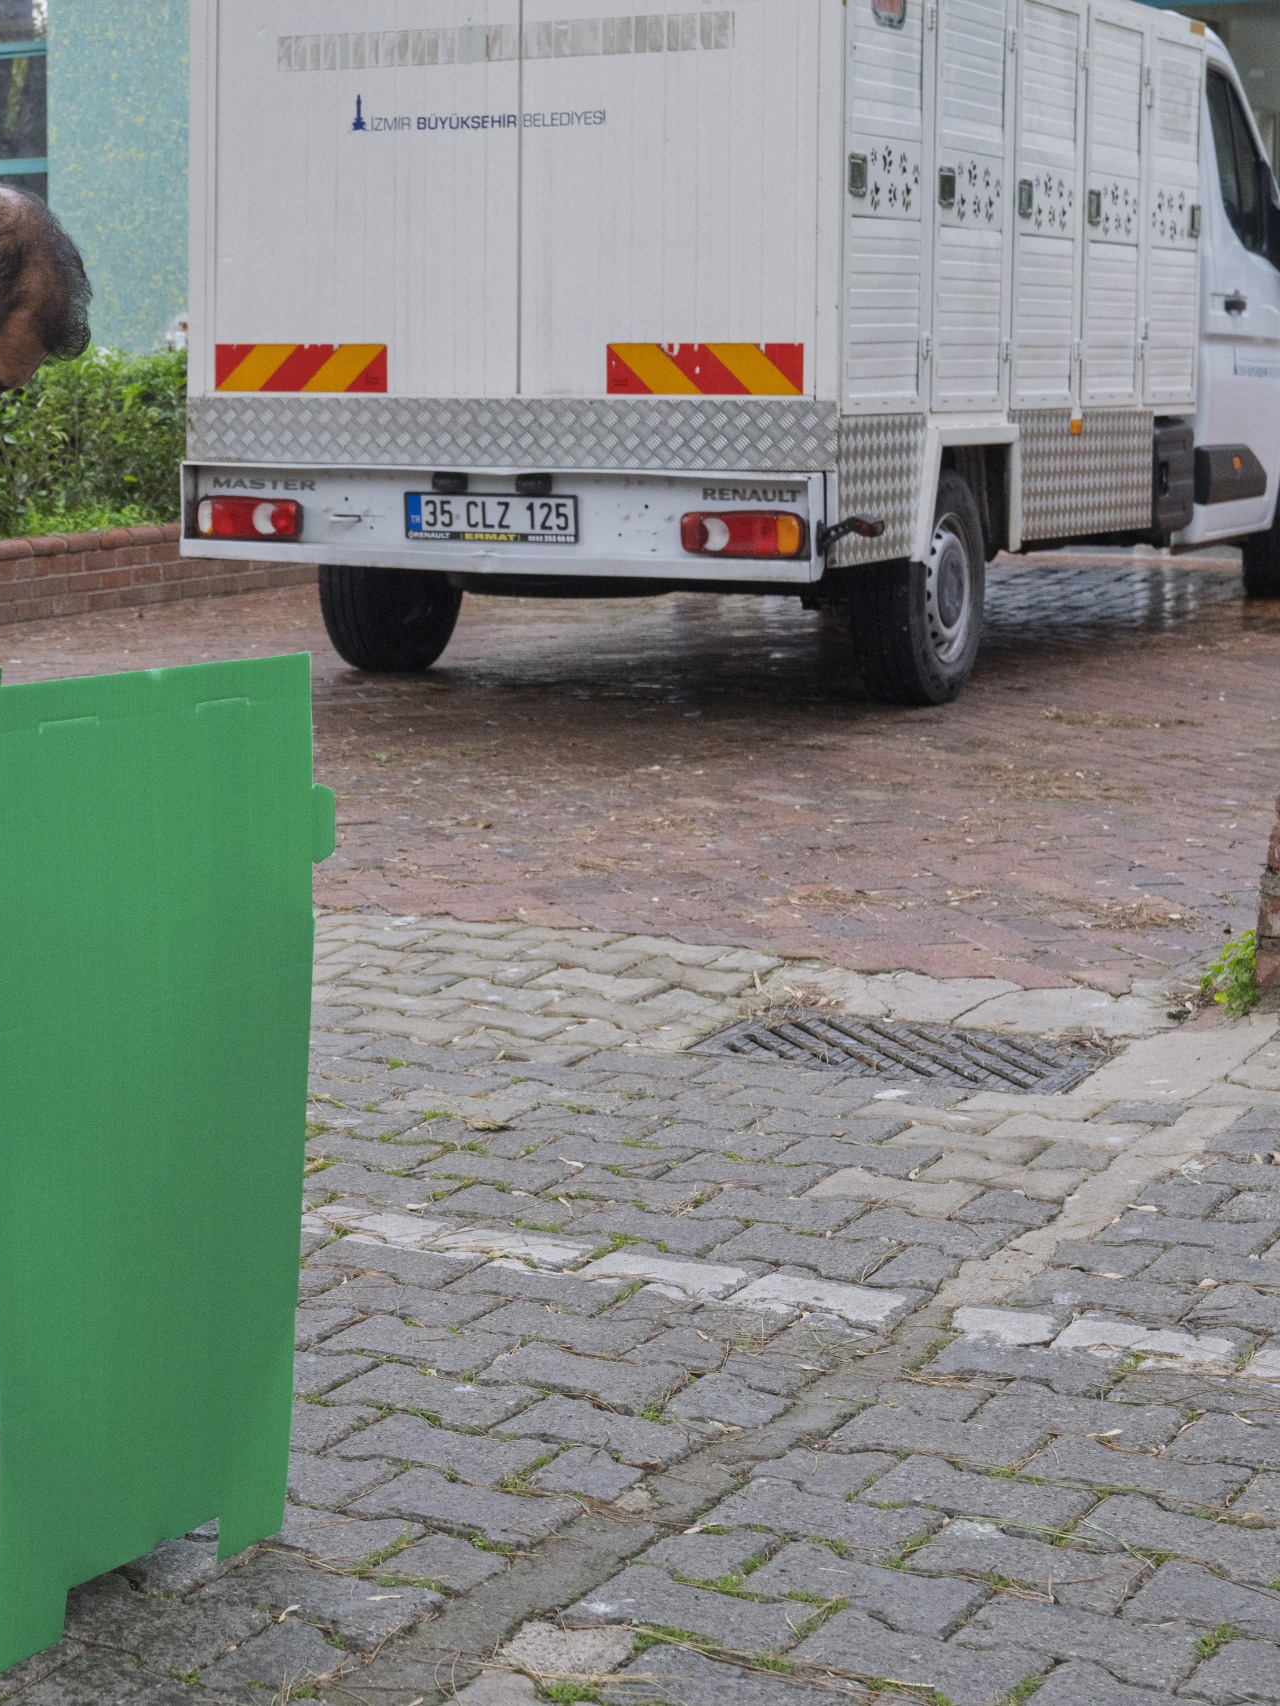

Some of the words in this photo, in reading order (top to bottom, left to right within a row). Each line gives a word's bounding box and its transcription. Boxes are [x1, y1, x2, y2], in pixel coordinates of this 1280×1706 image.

[213, 477, 316, 492] MASTER
[703, 487, 800, 503] RENAULT
[410, 515, 421, 524] TR
[424, 500, 453, 528] 35
[466, 501, 511, 529] CLZ
[526, 502, 569, 531] 125
[464, 533, 516, 541] ERMAT
